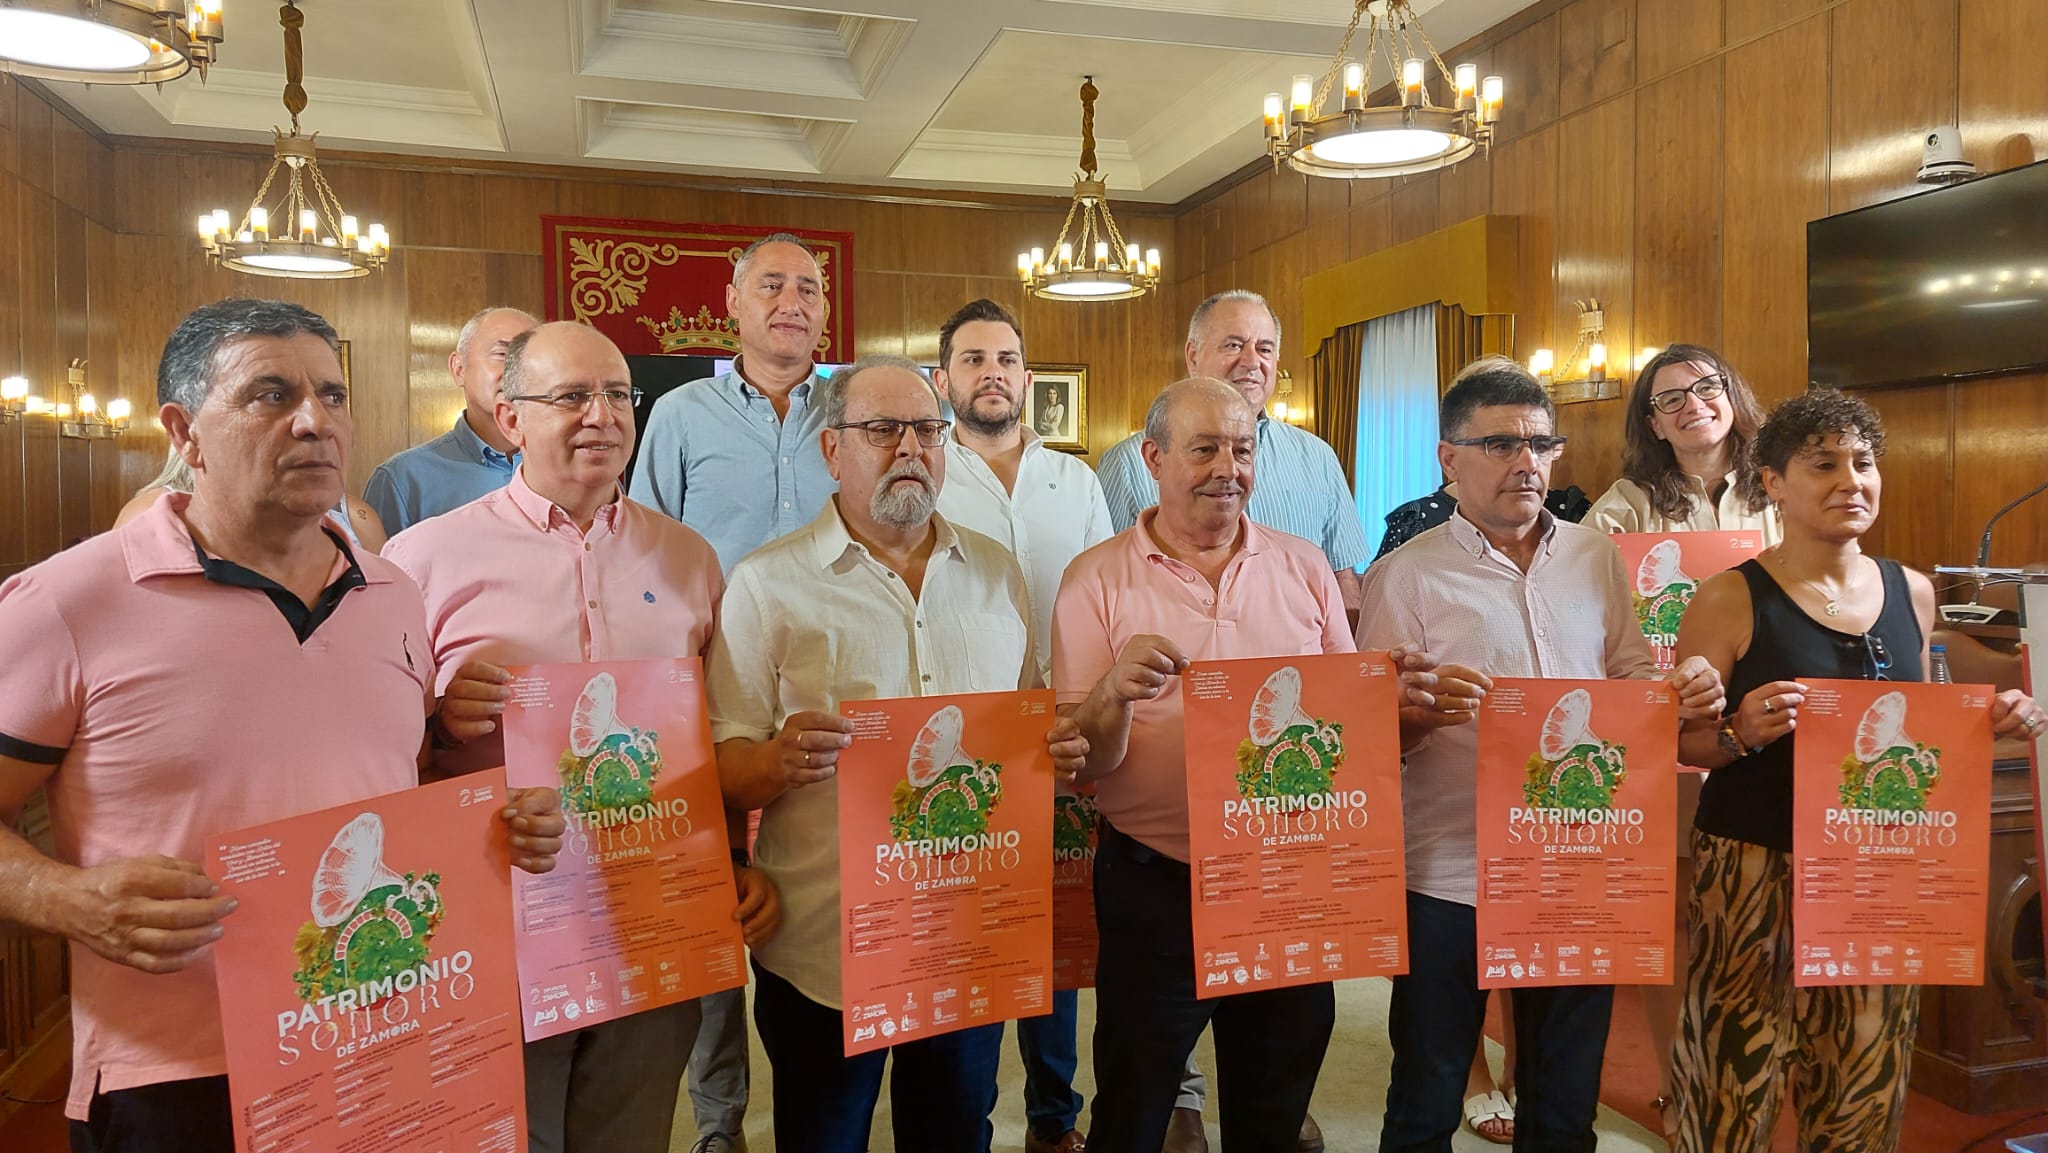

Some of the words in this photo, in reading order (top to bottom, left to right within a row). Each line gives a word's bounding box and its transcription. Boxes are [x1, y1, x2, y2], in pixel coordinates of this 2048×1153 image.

[1224, 790, 1367, 818] PATRIMONIO
[1224, 809, 1368, 840] SONORO
[1510, 807, 1644, 825] PATRIMONIO
[1825, 808, 1957, 828] PATRIMONIO
[569, 816, 692, 857] ONORO
[1263, 837, 1277, 846] DE
[1279, 833, 1325, 844] ZAMORA
[1508, 824, 1644, 845] SONORO
[1823, 824, 1957, 847] SONORO
[587, 855, 601, 864] DE
[604, 847, 651, 862] ZAMORA
[876, 830, 1020, 863] PATRIMONIO
[1544, 846, 1557, 854] DE
[1559, 846, 1602, 854] ZAMORA
[1858, 846, 1871, 854] DE
[1873, 846, 1915, 855] ZAMORA
[874, 850, 1020, 886] SONORO
[914, 881, 929, 892] DE
[931, 875, 977, 889] ZAMORA
[277, 950, 473, 1038] PATRIMONIO
[279, 973, 475, 1066] SONORO
[336, 1042, 356, 1058] DE
[359, 1018, 421, 1050] ZAMORA
